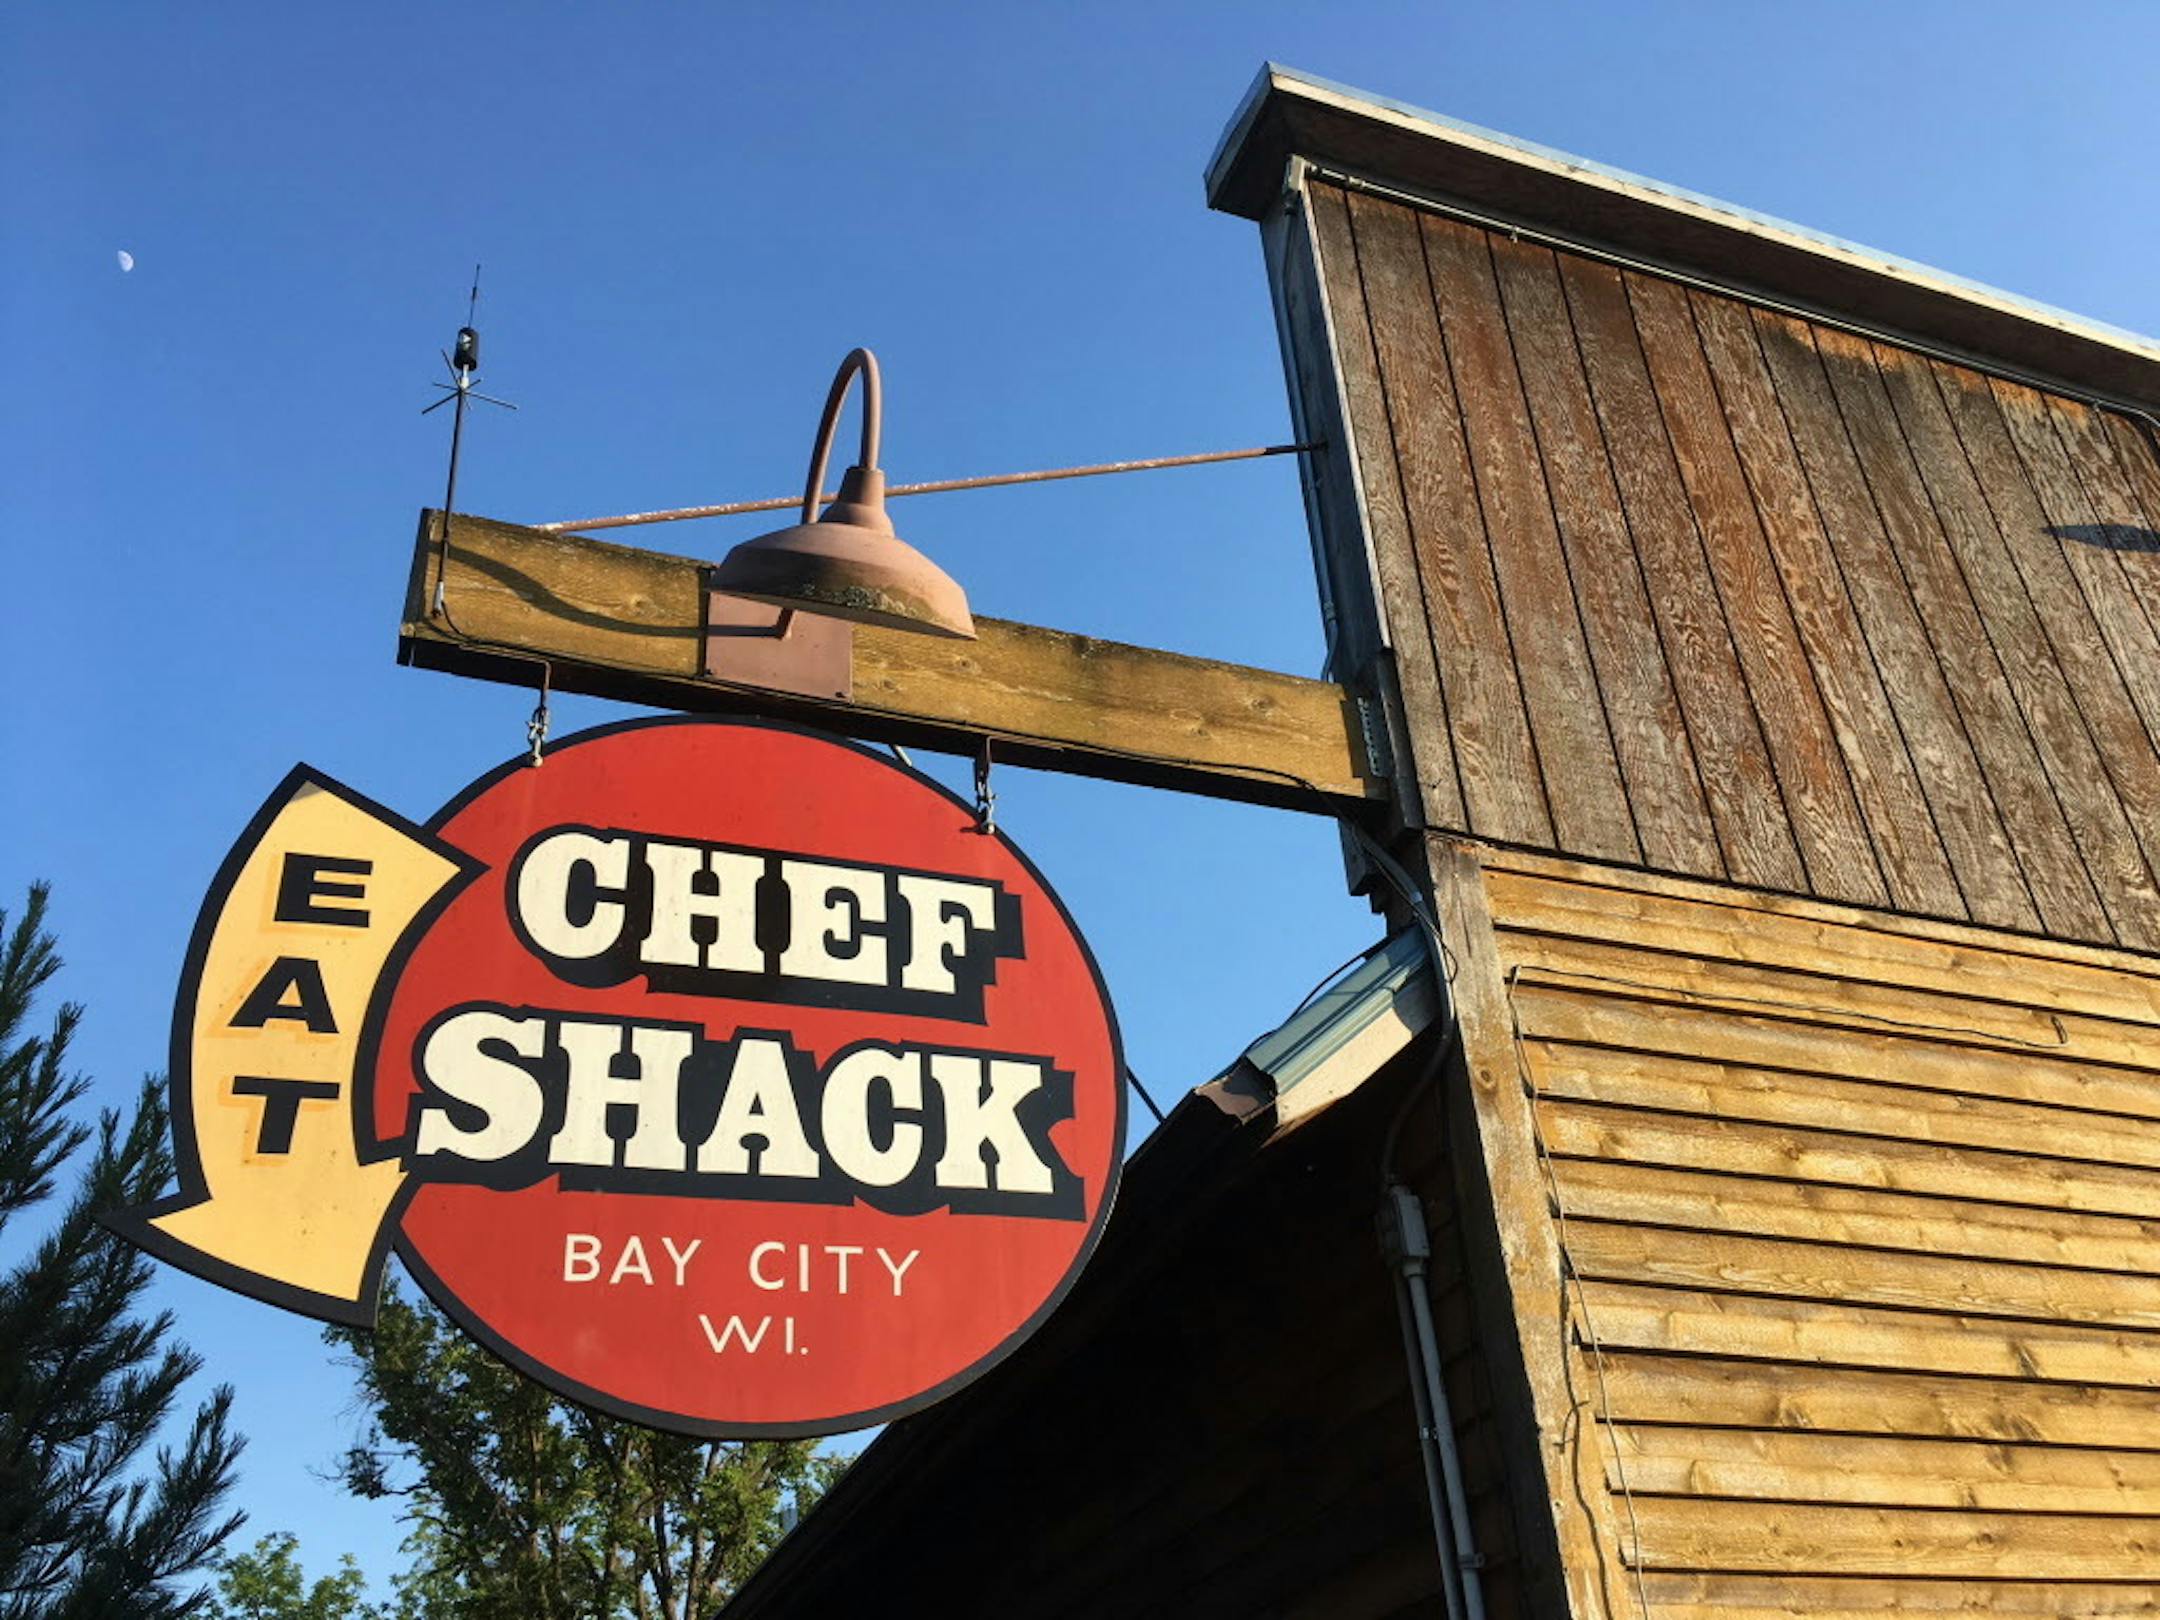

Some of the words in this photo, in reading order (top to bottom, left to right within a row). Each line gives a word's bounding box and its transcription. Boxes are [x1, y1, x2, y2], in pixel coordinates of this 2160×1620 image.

[518, 832, 996, 994] CHEF
[228, 852, 373, 1155] EAT
[415, 1011, 1054, 1194] SHACK
[563, 1233, 701, 1286] BAY
[748, 1241, 920, 1297] CITY
[699, 1314, 809, 1355] WI.
